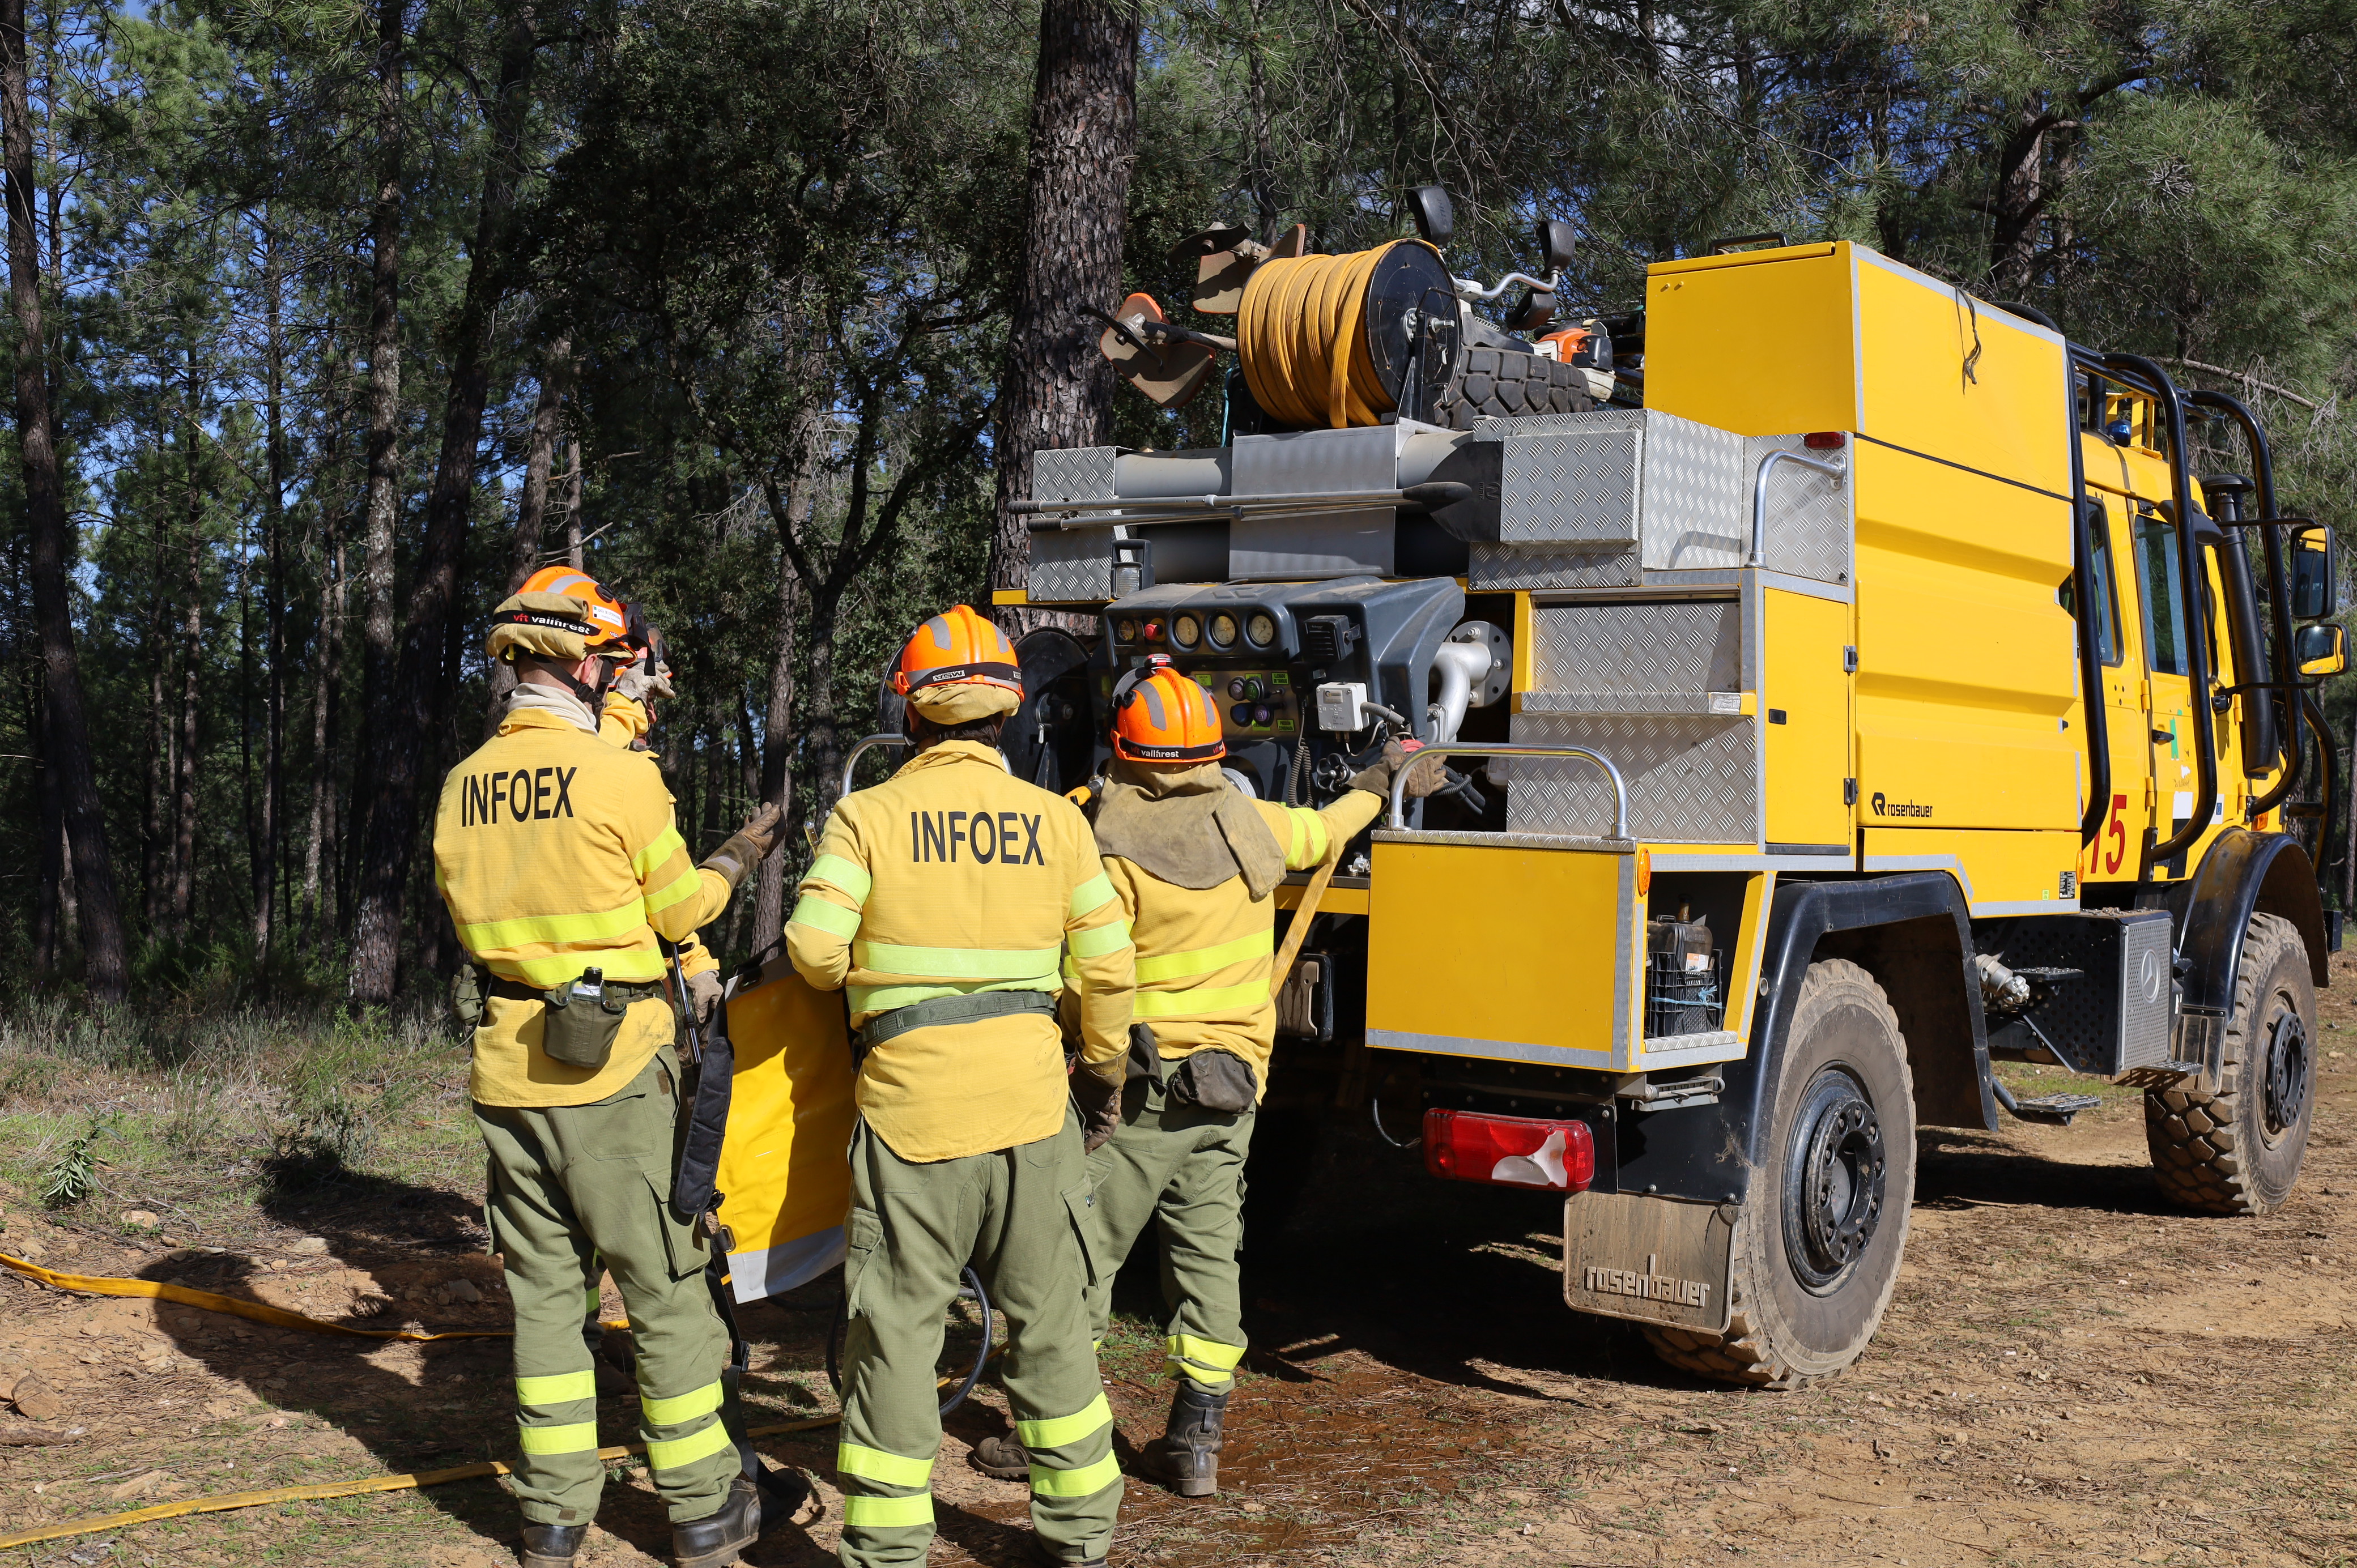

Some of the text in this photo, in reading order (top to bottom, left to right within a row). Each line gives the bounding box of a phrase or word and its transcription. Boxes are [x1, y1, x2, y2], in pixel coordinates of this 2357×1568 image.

[513, 613, 529, 622] vft
[934, 671, 964, 680] MSA
[1141, 749, 1179, 758] vallfirest
[462, 766, 577, 827] INFOEX
[1887, 799, 1933, 817] rosenbauer
[911, 811, 1045, 866] INFOEX
[1585, 1253, 1710, 1307] rosenbauer
